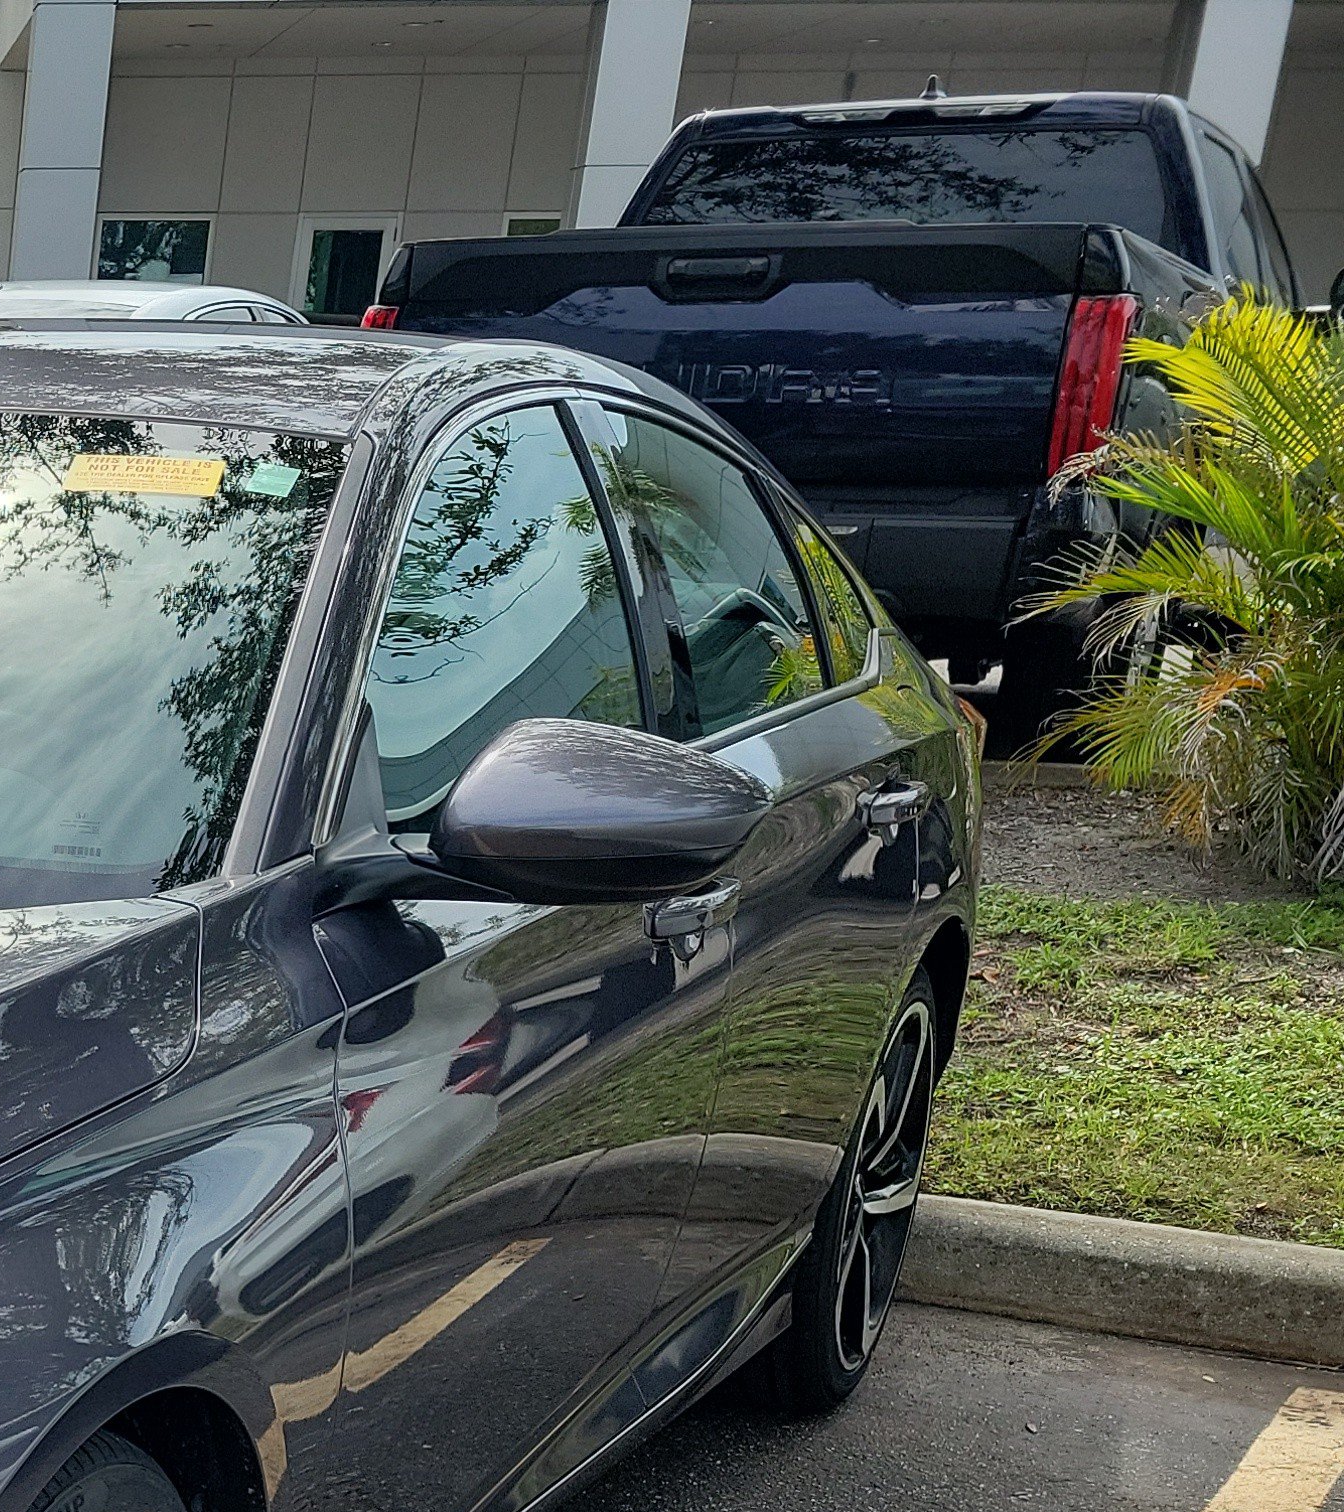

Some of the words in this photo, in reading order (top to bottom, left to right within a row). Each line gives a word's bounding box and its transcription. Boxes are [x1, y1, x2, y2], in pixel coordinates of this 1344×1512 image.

[86, 456, 121, 464] THIS
[125, 457, 191, 467] VEHICLE
[197, 461, 212, 469] IS
[88, 464, 121, 472] NOT
[125, 465, 155, 473] FOR
[161, 467, 201, 476] SALE
